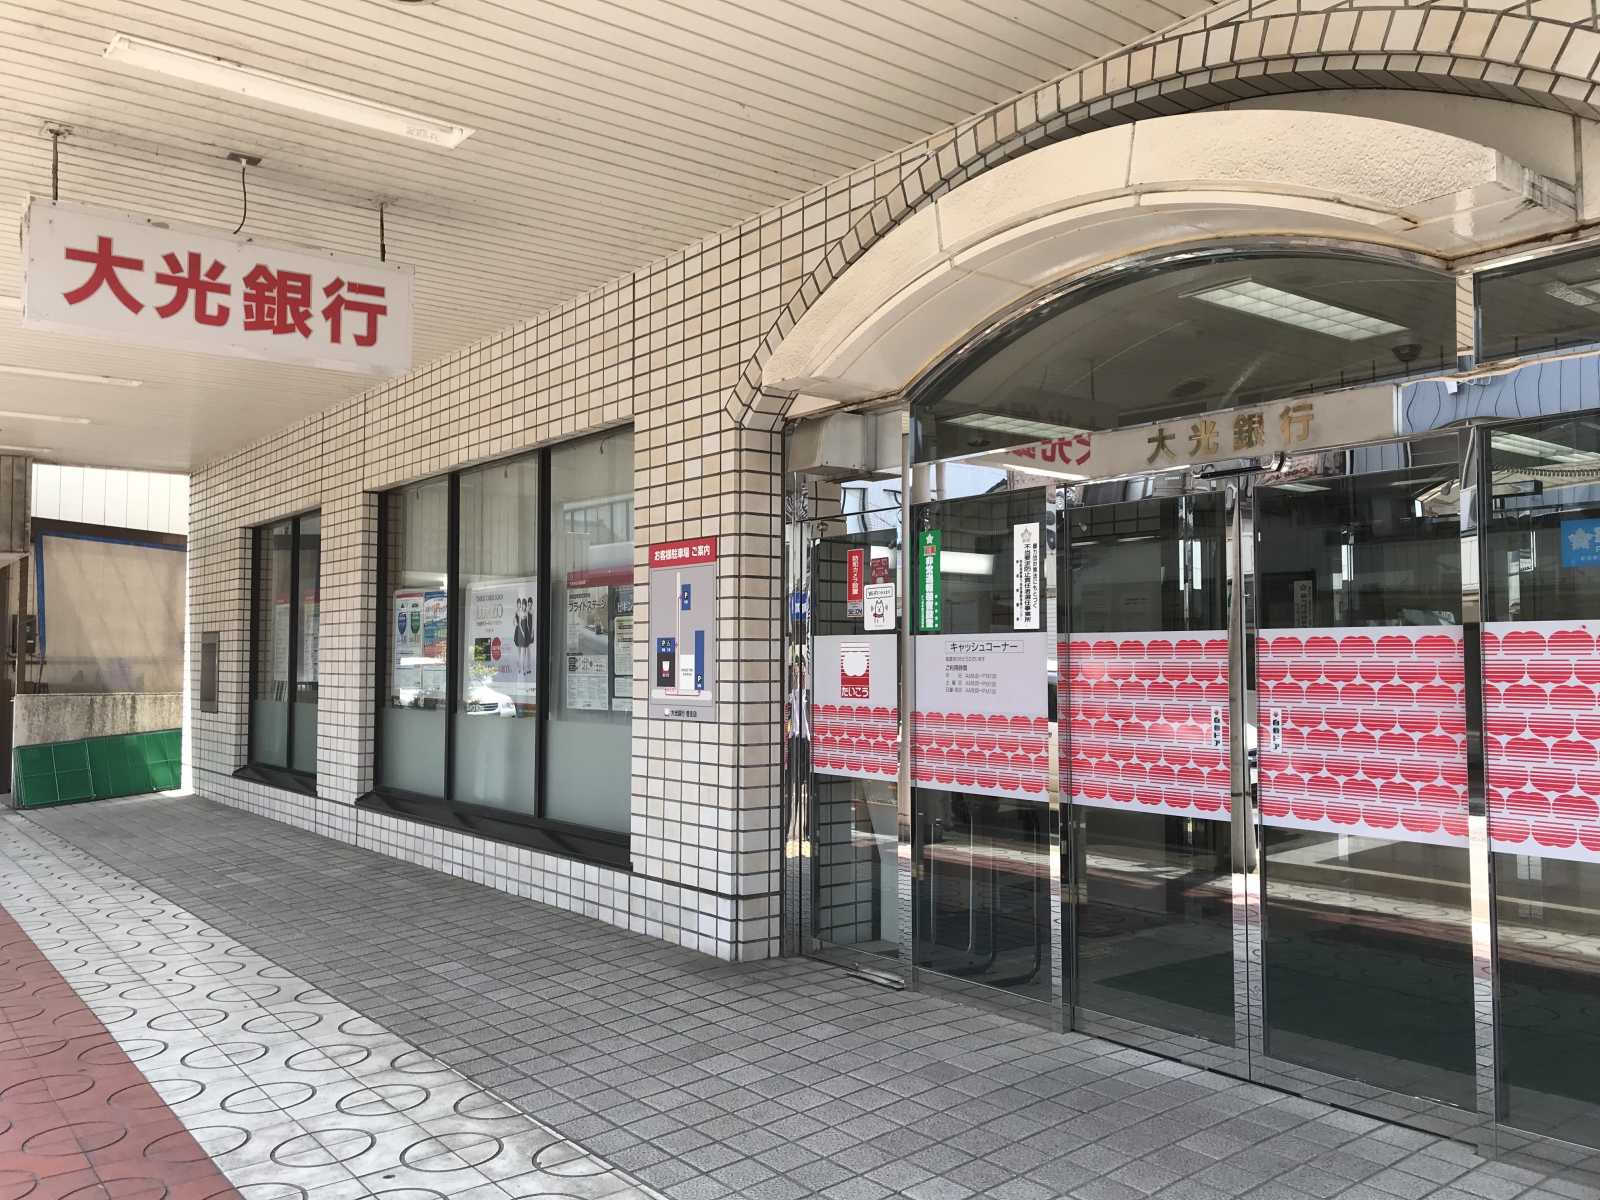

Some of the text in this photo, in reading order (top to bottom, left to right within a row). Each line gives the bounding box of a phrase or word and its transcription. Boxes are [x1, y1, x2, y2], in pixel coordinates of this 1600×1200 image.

[63, 235, 388, 348] 大光銀行
[1147, 403, 1314, 465] 大光銀行
[654, 544, 711, 561] お客様駐車場 ご案内
[950, 641, 1019, 653] キャッシュコーナー
[841, 686, 869, 698] たいこう
